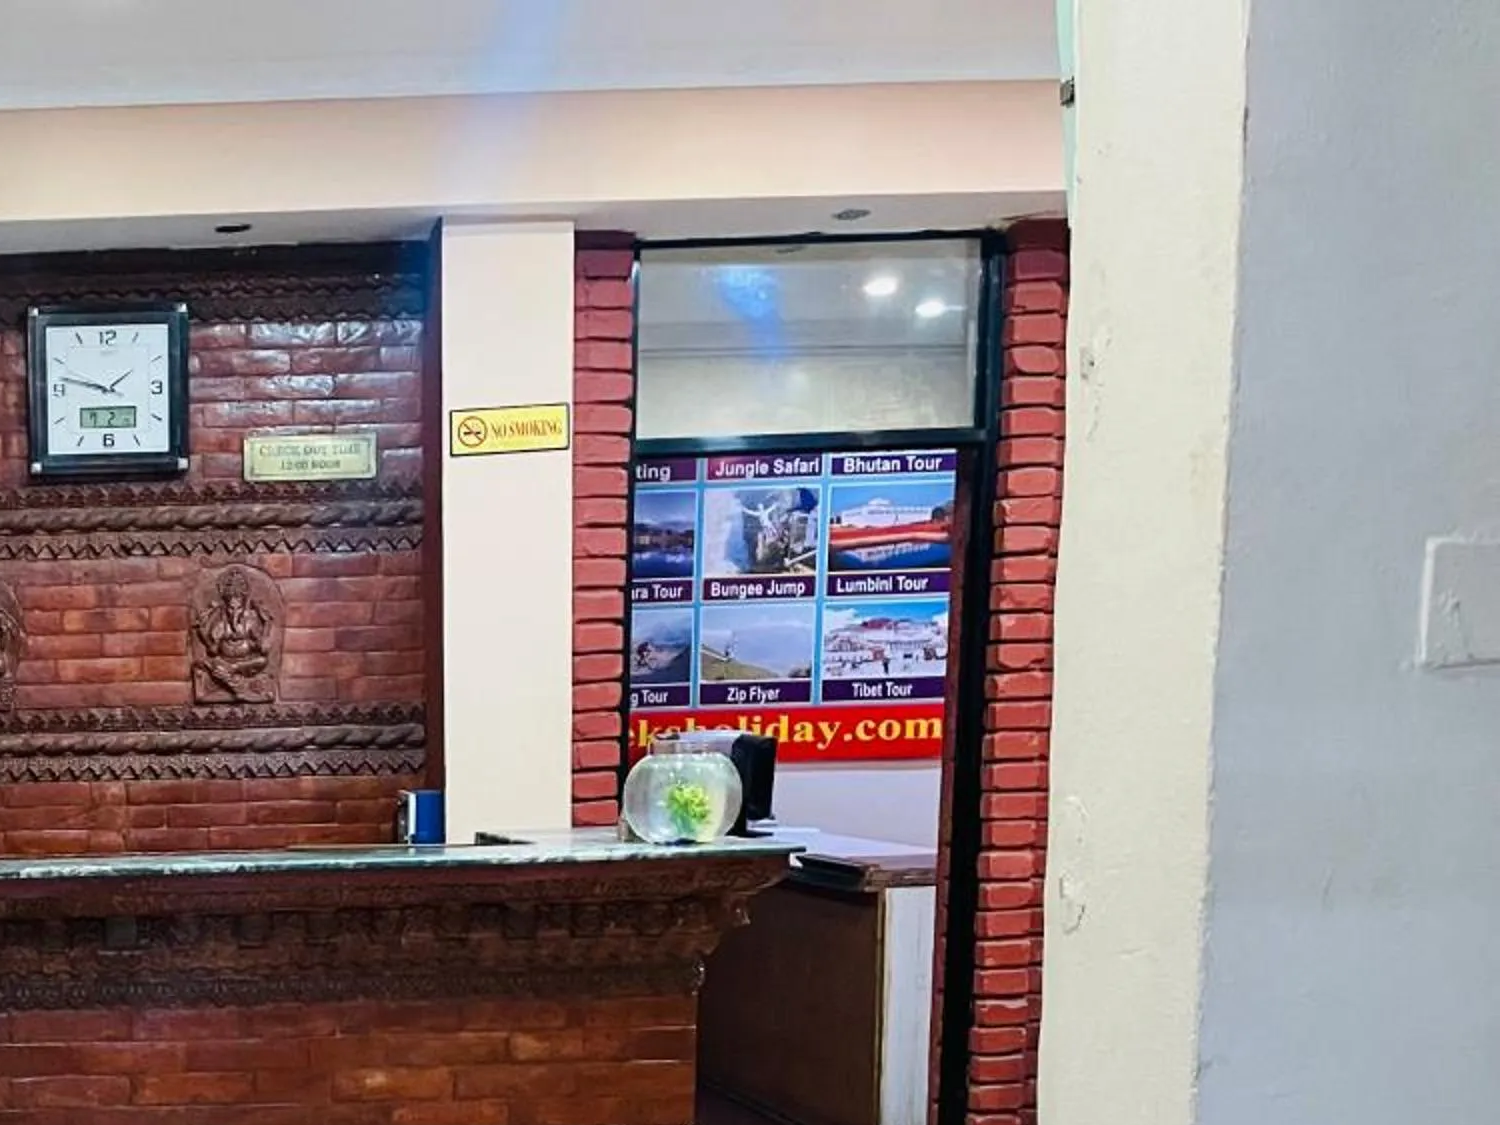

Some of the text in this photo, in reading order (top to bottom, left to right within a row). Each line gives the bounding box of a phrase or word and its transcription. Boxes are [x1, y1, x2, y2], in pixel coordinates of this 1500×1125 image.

[99, 329, 117, 345] 12
[53, 383, 66, 397] 9
[151, 380, 163, 395] 3
[103, 433, 115, 448] 6
[715, 457, 819, 478] Jungle Safari
[843, 455, 942, 473] Bhutan Tour
[631, 583, 683, 599] ra Tour
[711, 579, 806, 600] Bungee Jump
[836, 575, 928, 592] Lumbini Tour
[641, 689, 669, 704] Tour
[727, 685, 780, 704] Zip Flyer
[852, 681, 913, 698] Tibet Tour
